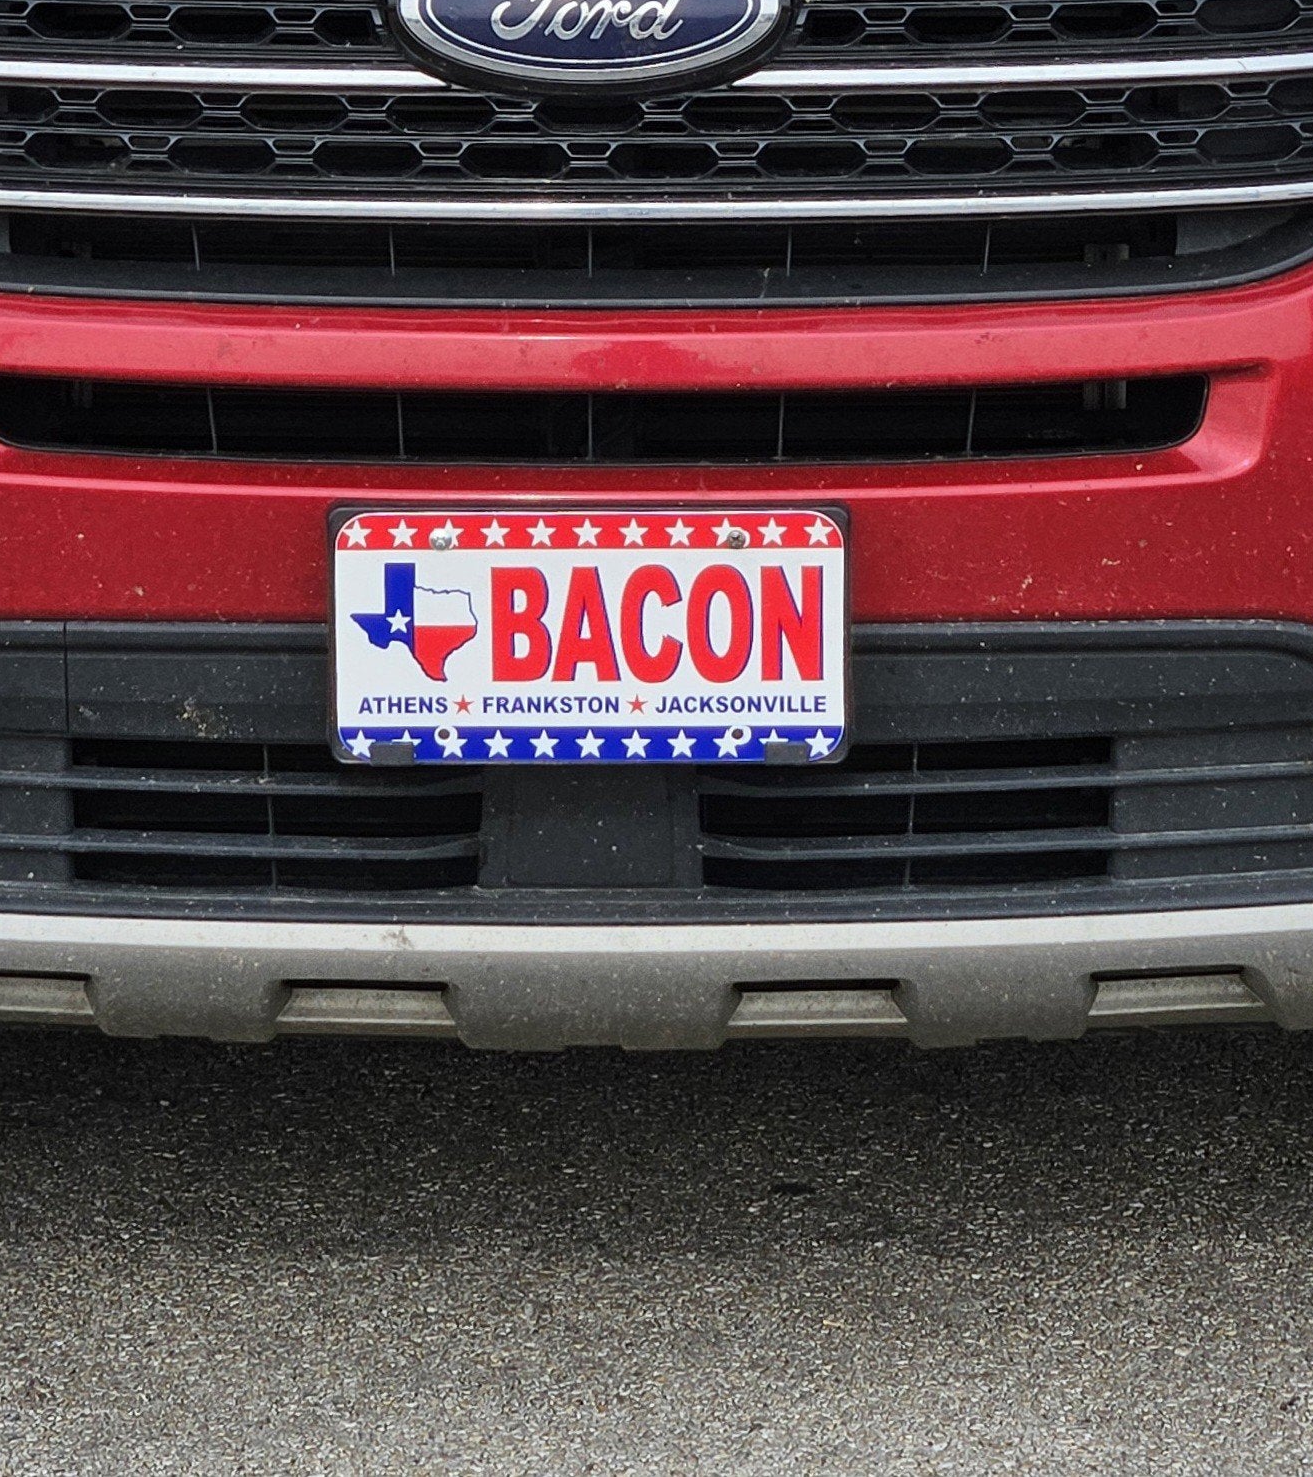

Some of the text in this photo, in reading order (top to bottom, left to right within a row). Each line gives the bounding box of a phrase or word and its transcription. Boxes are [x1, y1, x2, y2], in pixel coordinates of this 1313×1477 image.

[490, 564, 824, 683] BACON
[358, 695, 827, 715] ATHENS FRANKSTON JACKSONVILLE
